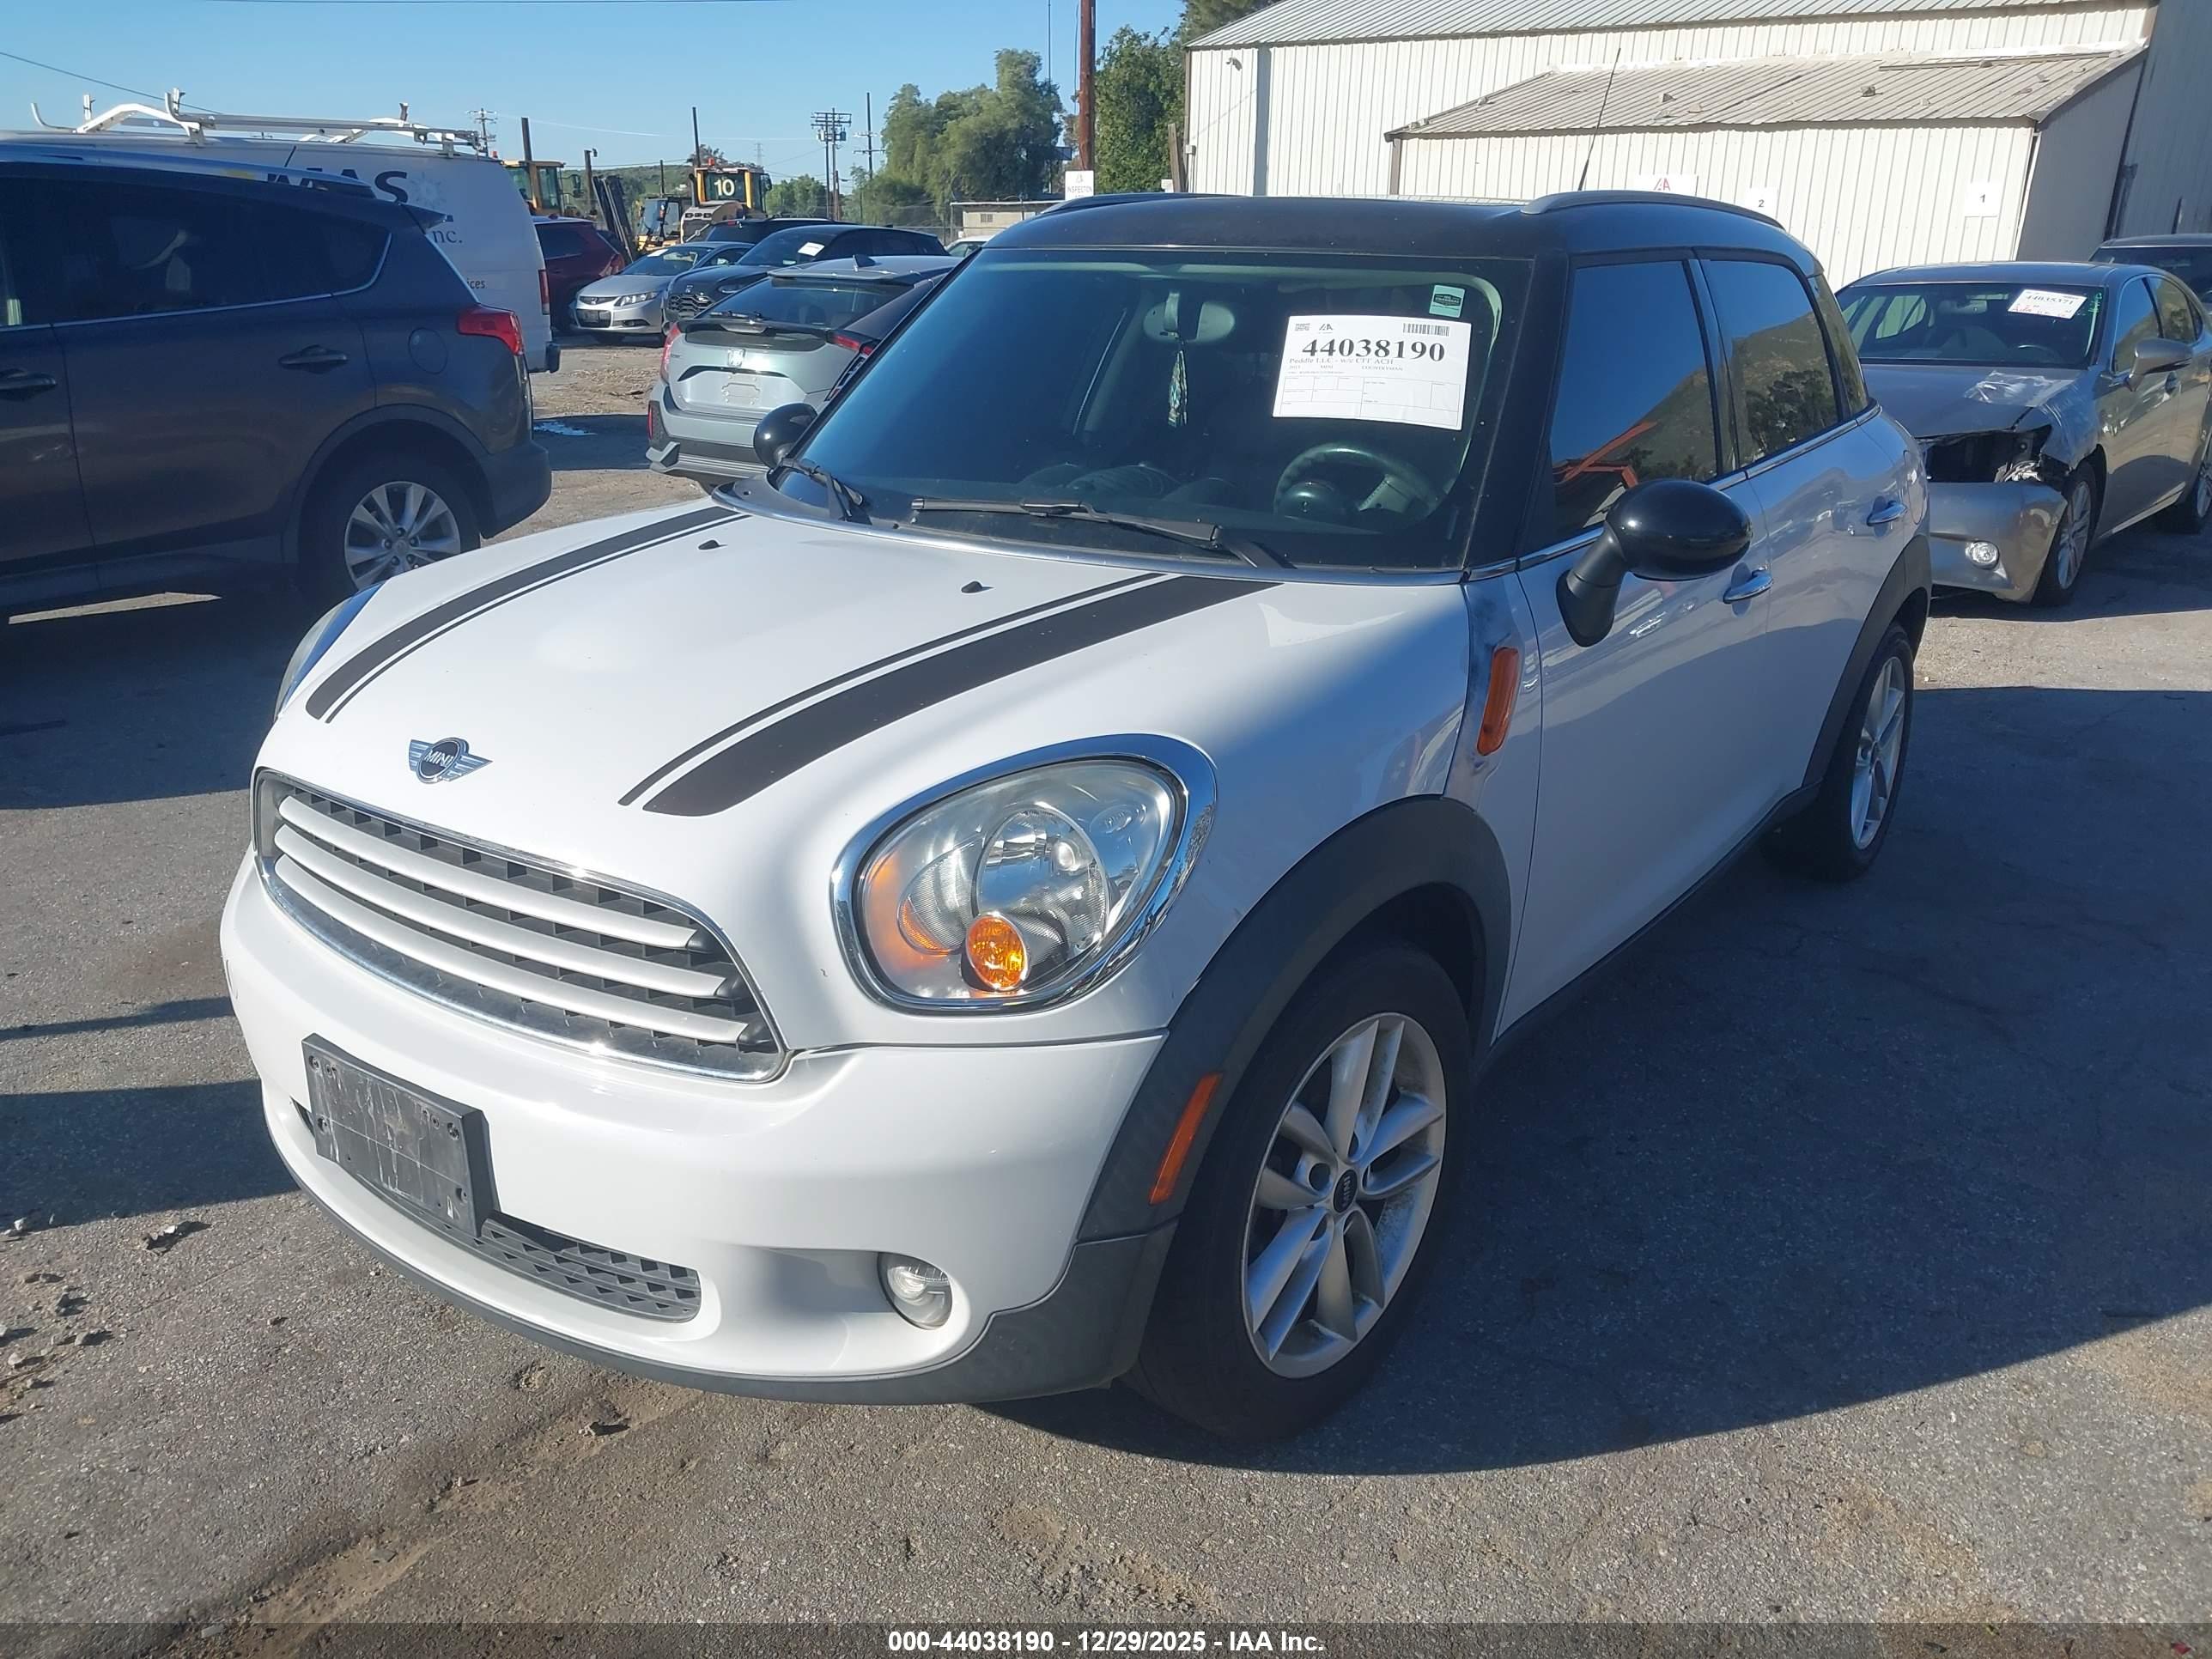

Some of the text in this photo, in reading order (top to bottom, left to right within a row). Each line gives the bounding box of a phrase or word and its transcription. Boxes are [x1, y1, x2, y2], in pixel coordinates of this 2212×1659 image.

[714, 179, 735, 196] 10
[1758, 199, 1765, 208] 2
[1979, 193, 1985, 204] 1
[432, 230, 463, 243] nc.
[1302, 338, 1445, 362] 44038190
[423, 749, 454, 768] MINI
